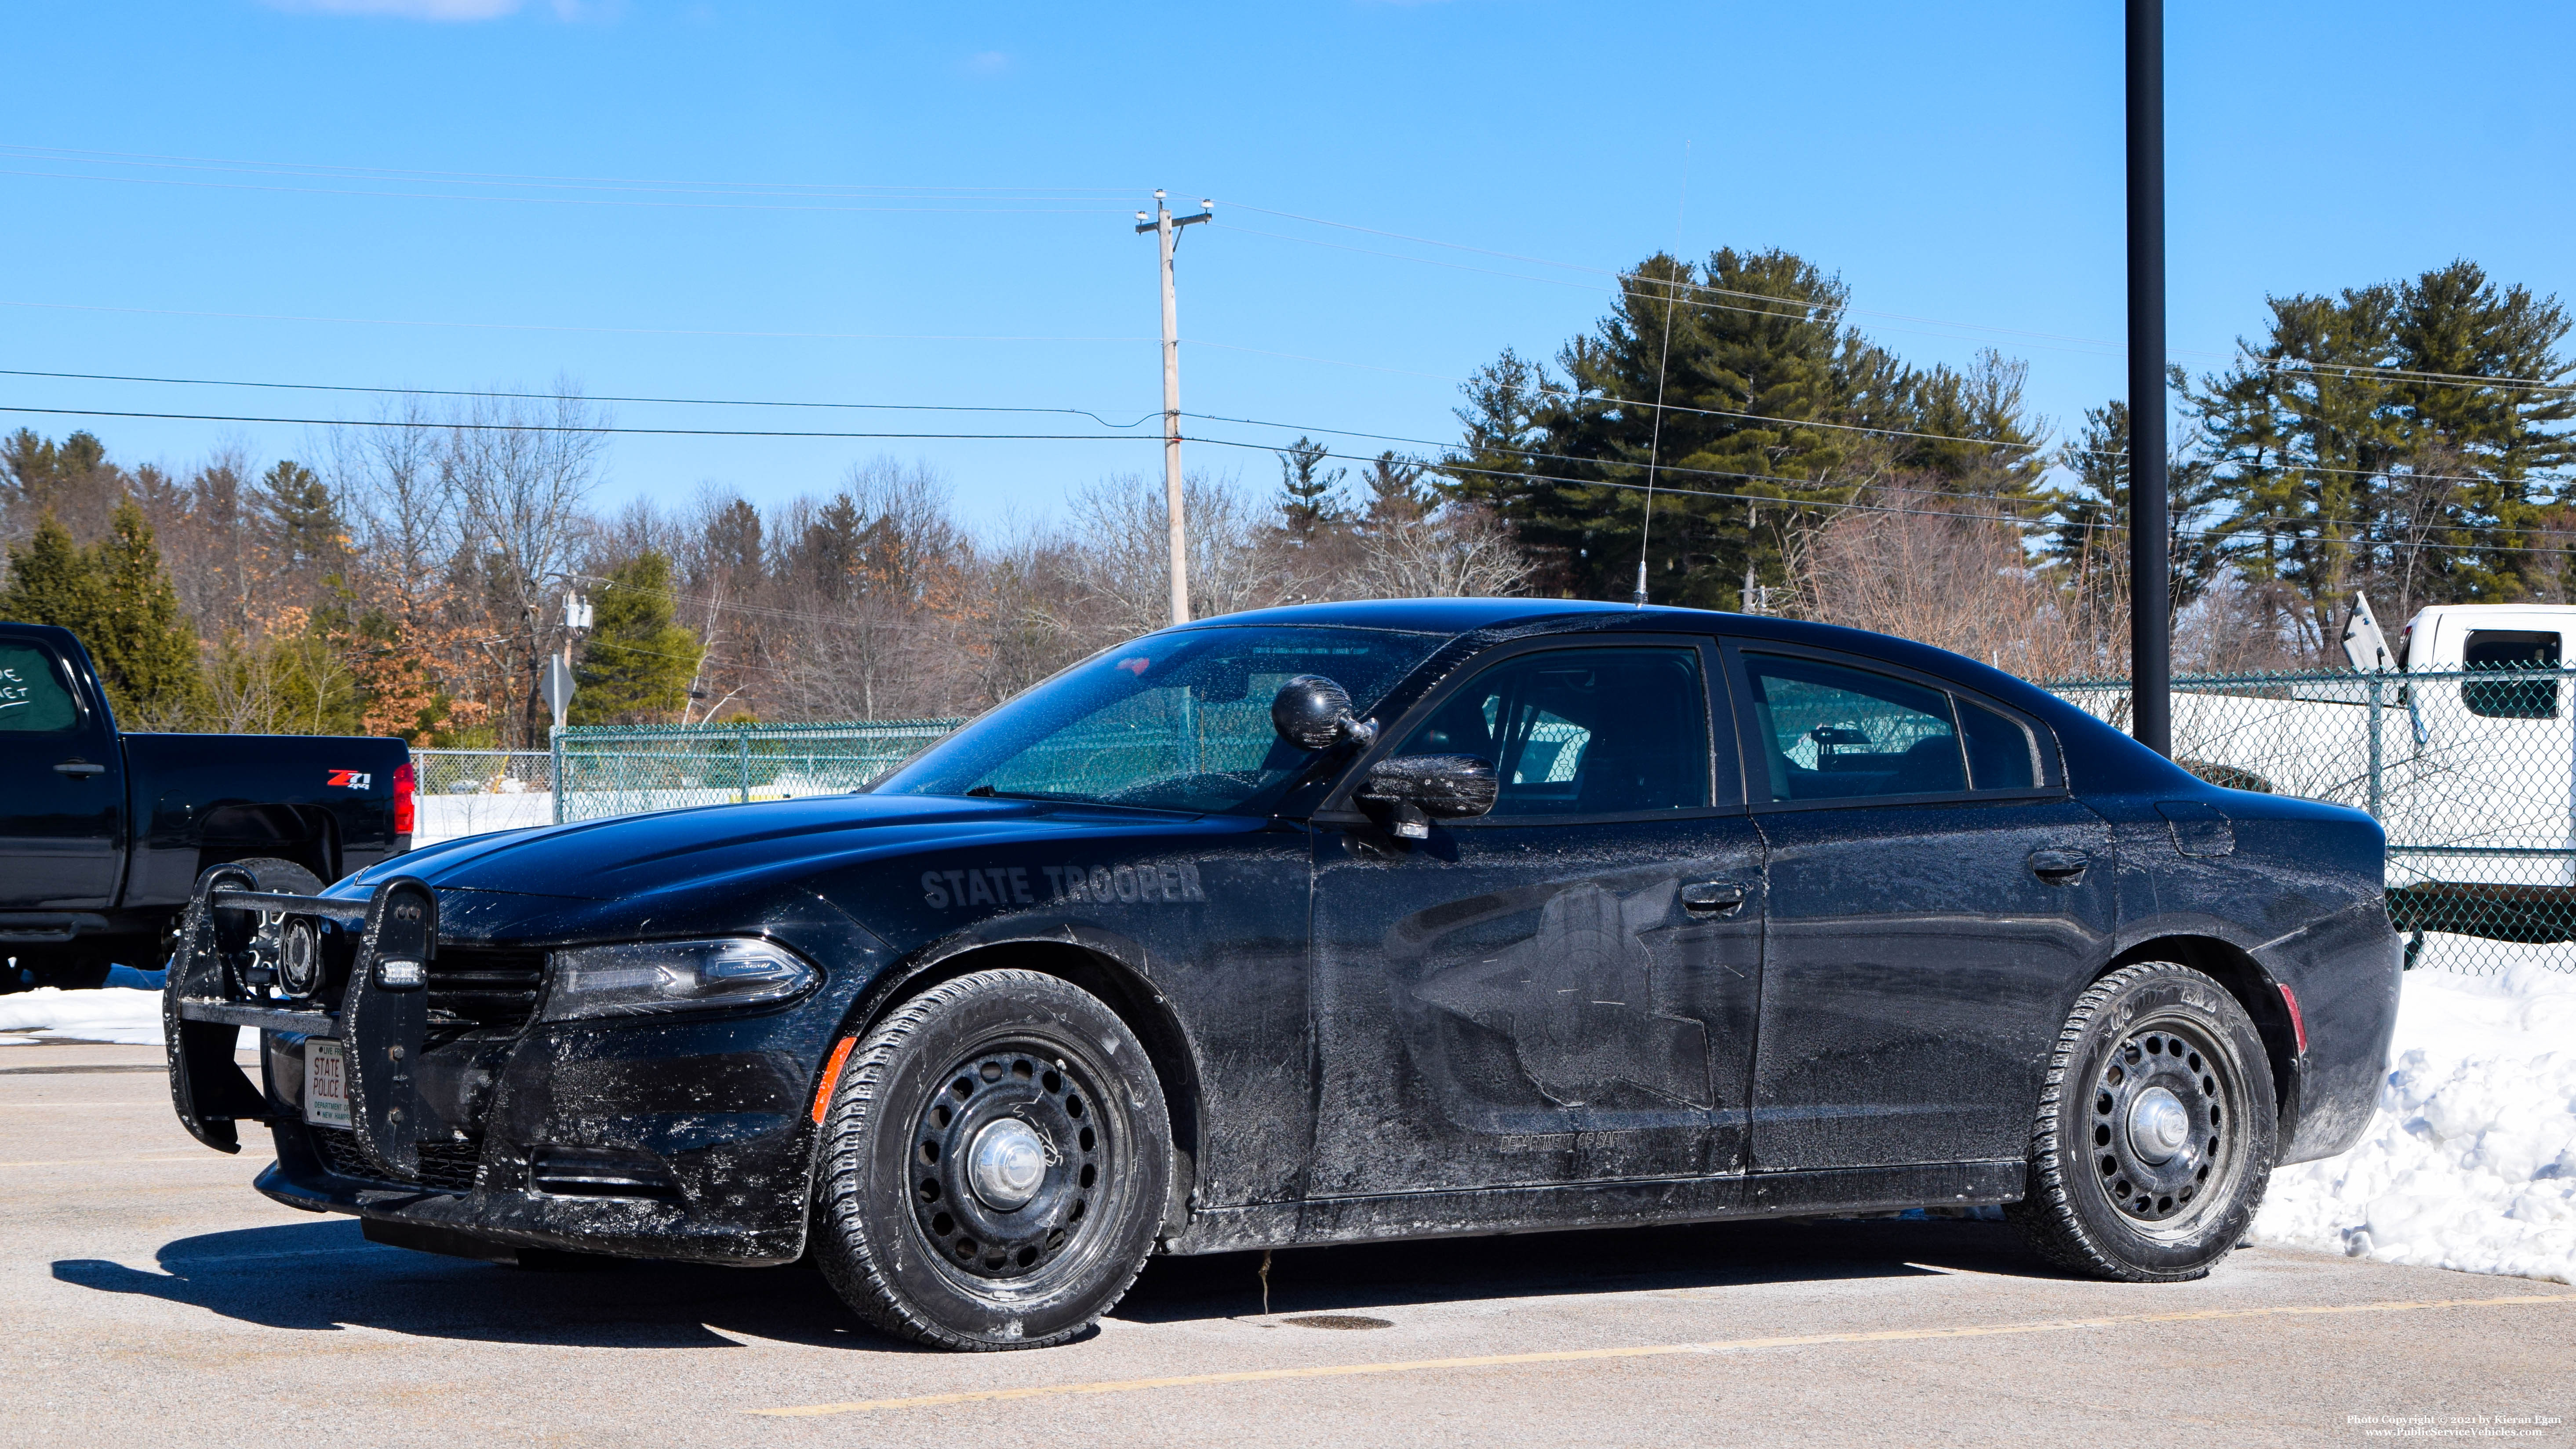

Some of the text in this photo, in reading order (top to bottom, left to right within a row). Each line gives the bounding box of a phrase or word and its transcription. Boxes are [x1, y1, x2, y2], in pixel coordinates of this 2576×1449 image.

[327, 770, 371, 786] Z71
[922, 864, 1204, 909] STATE TROOPER
[324, 1046, 333, 1055] LIVE
[314, 1057, 339, 1078] STATE
[313, 1078, 338, 1098] POLICE
[314, 1101, 342, 1110] DEPARTMENT
[1500, 1133, 1575, 1152] DEPARTMENT
[1577, 1132, 1594, 1149] OF
